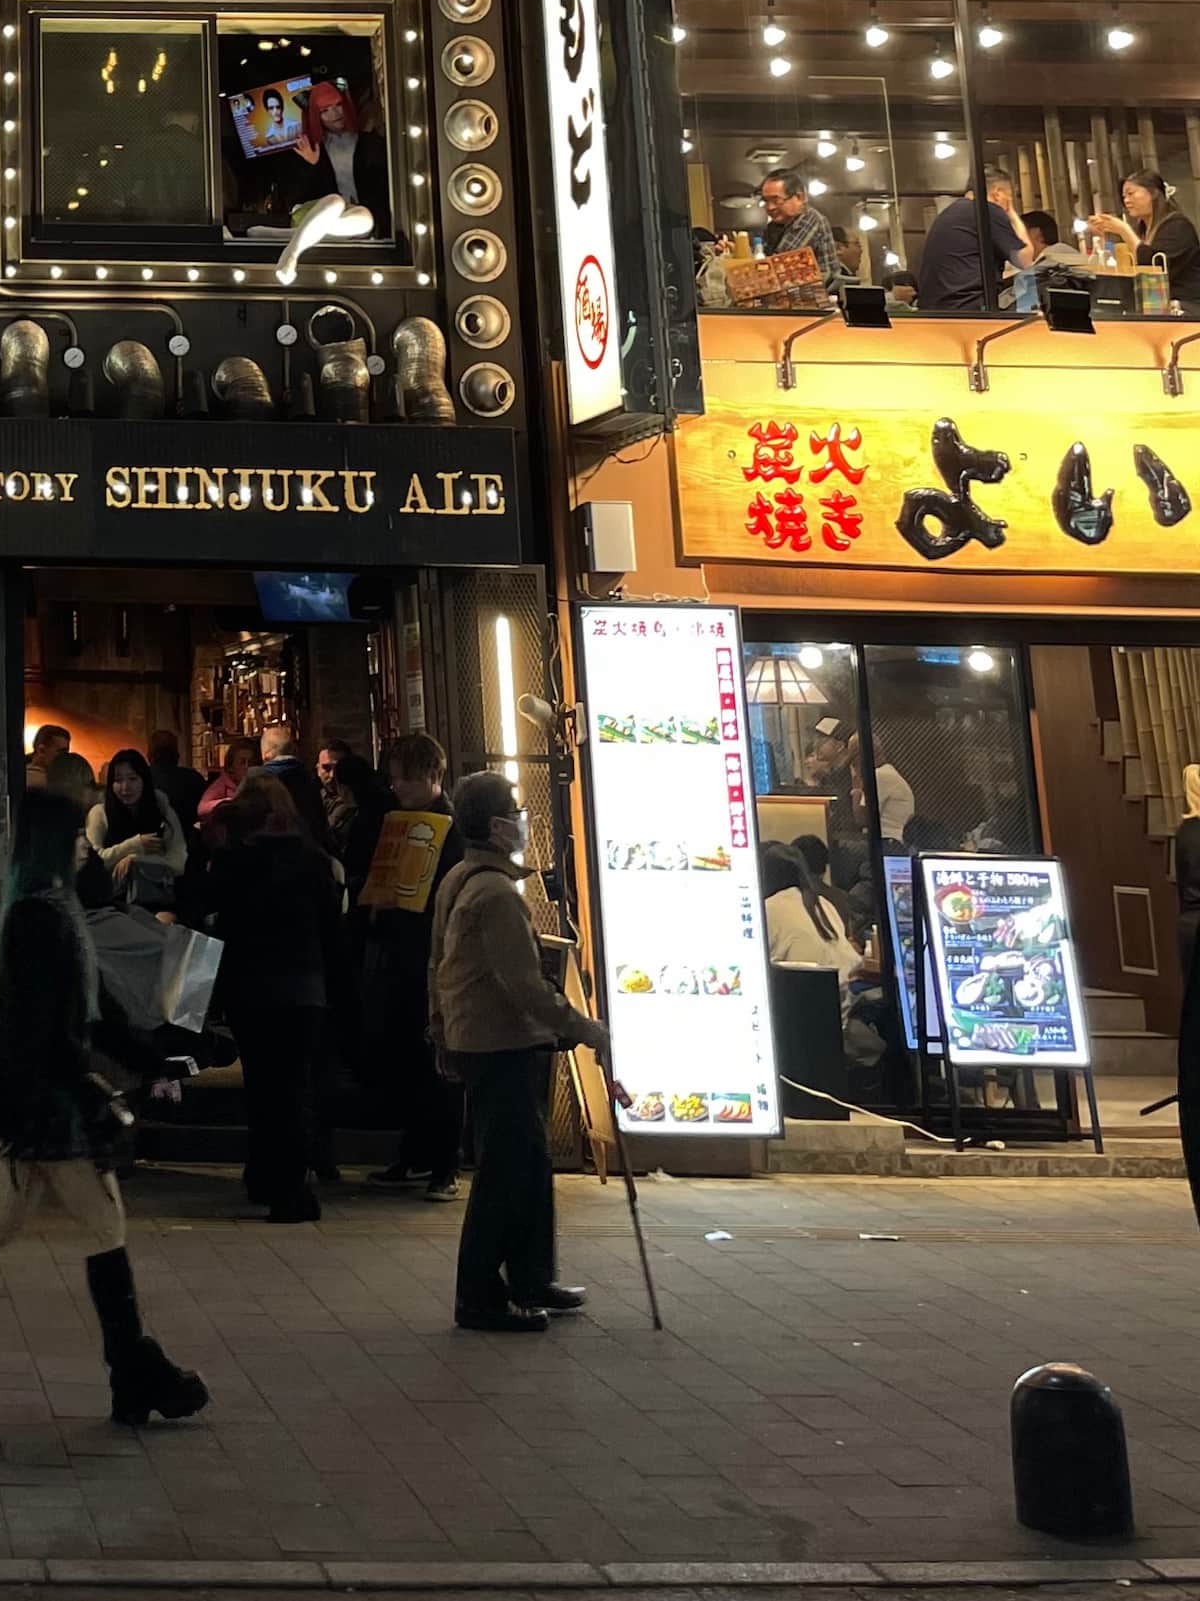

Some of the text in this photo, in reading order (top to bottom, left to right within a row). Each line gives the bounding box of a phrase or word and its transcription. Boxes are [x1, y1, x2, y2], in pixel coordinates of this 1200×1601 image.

[575, 272, 607, 345] 酒場
[741, 421, 870, 486] 炭火
[105, 466, 506, 515] SHINJUKU ALE
[744, 487, 865, 553] 焼き
